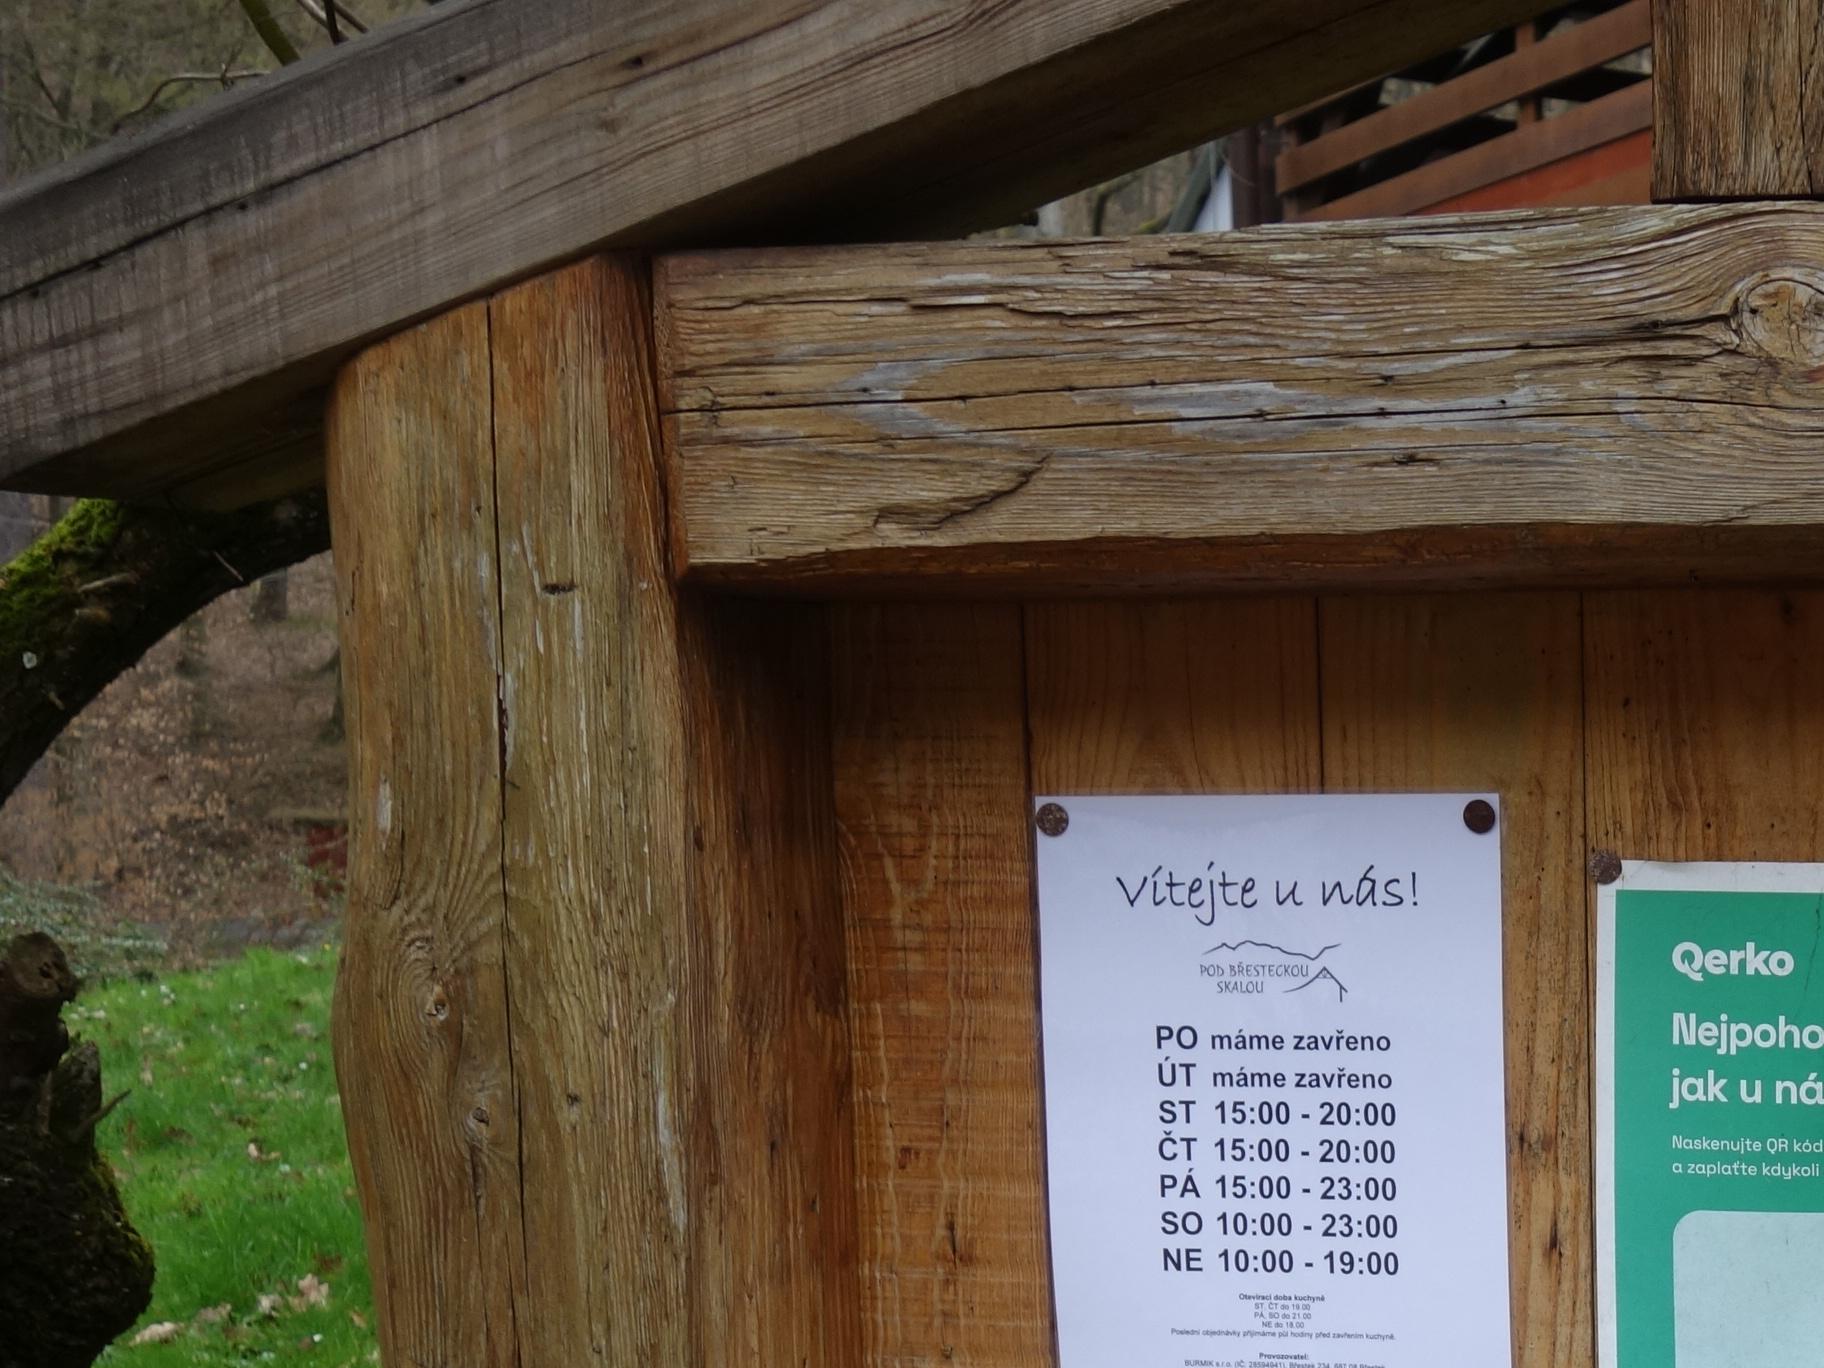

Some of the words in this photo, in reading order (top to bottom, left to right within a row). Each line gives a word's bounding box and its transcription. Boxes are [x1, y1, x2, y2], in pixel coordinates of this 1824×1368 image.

[1116, 861, 1258, 926] Vítejte
[1276, 880, 1303, 906] u
[1322, 864, 1419, 907] nás!
[1199, 964, 1224, 977] POD
[1229, 961, 1309, 978] BŘESTECKOU
[1672, 942, 1795, 981] Qerko
[1217, 981, 1264, 994] SKALOU
[1156, 1025, 1198, 1050] PO
[1211, 1029, 1285, 1051] máme
[1293, 1030, 1391, 1051] zavřeno
[1158, 1056, 1196, 1088] ÚT
[1213, 1067, 1286, 1088] máme
[1294, 1067, 1392, 1088] zavřeno
[1669, 1068, 1728, 1109] jak
[1740, 1080, 1761, 1104] u
[1159, 1100, 1196, 1124] ST
[1214, 1101, 1290, 1125] 15:00
[1319, 1102, 1396, 1126] 20:00
[1158, 1130, 1198, 1162] ČT
[1214, 1138, 1290, 1162] 15:00
[1319, 1139, 1396, 1164] 20:00
[1672, 1134, 1762, 1154] Naskenujte
[1767, 1138, 1789, 1155] QR
[1794, 1138, 1824, 1153] kód
[1672, 1162, 1682, 1174] a
[1687, 1161, 1757, 1178] zaplaťte
[1763, 1162, 1820, 1180] kdykoli
[1160, 1168, 1201, 1199] PÁ
[1215, 1175, 1291, 1199] 15:00
[1320, 1176, 1397, 1201] 23:00
[1161, 1211, 1203, 1235] SO
[1217, 1212, 1292, 1236] 10:00
[1321, 1213, 1398, 1238] 23:00
[1162, 1248, 1203, 1272] NE
[1218, 1249, 1294, 1273] 10:00
[1323, 1250, 1399, 1276] 19:00
